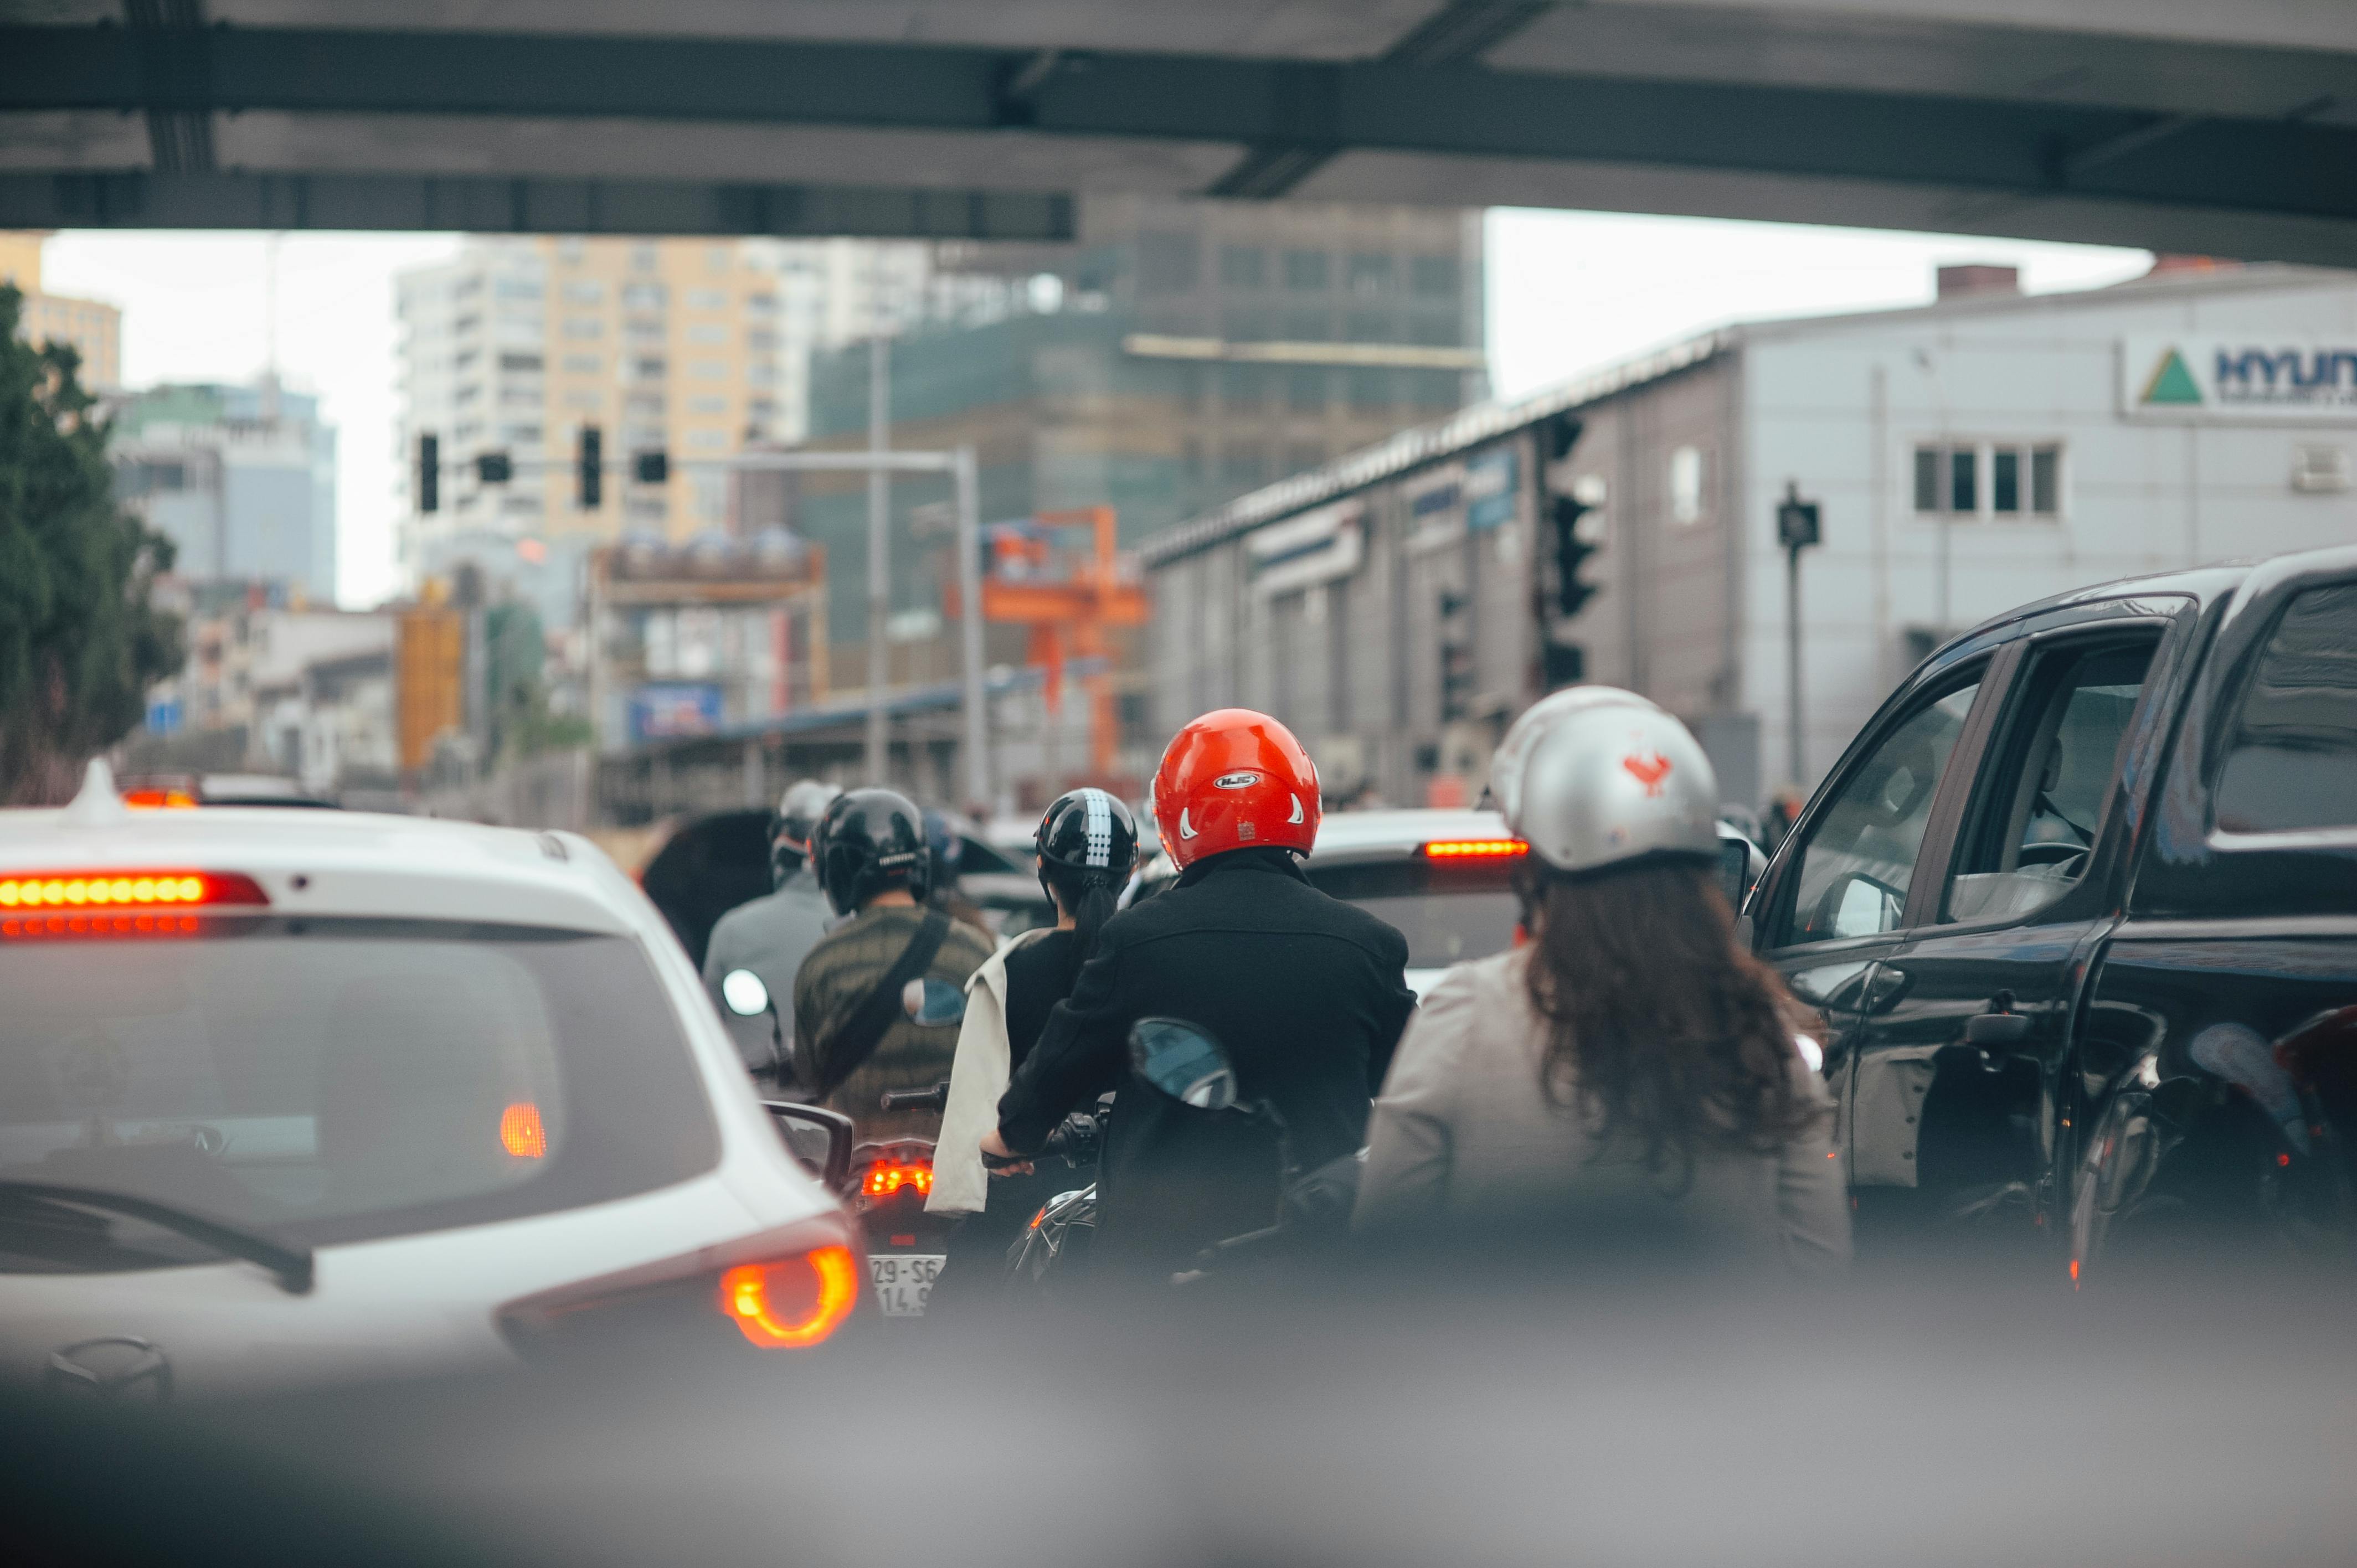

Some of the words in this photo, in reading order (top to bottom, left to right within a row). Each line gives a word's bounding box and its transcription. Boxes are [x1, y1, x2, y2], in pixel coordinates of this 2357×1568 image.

[1221, 776, 1250, 786] HJC
[873, 1260, 936, 1283] 29-S6
[875, 1287, 929, 1311] 14.9
